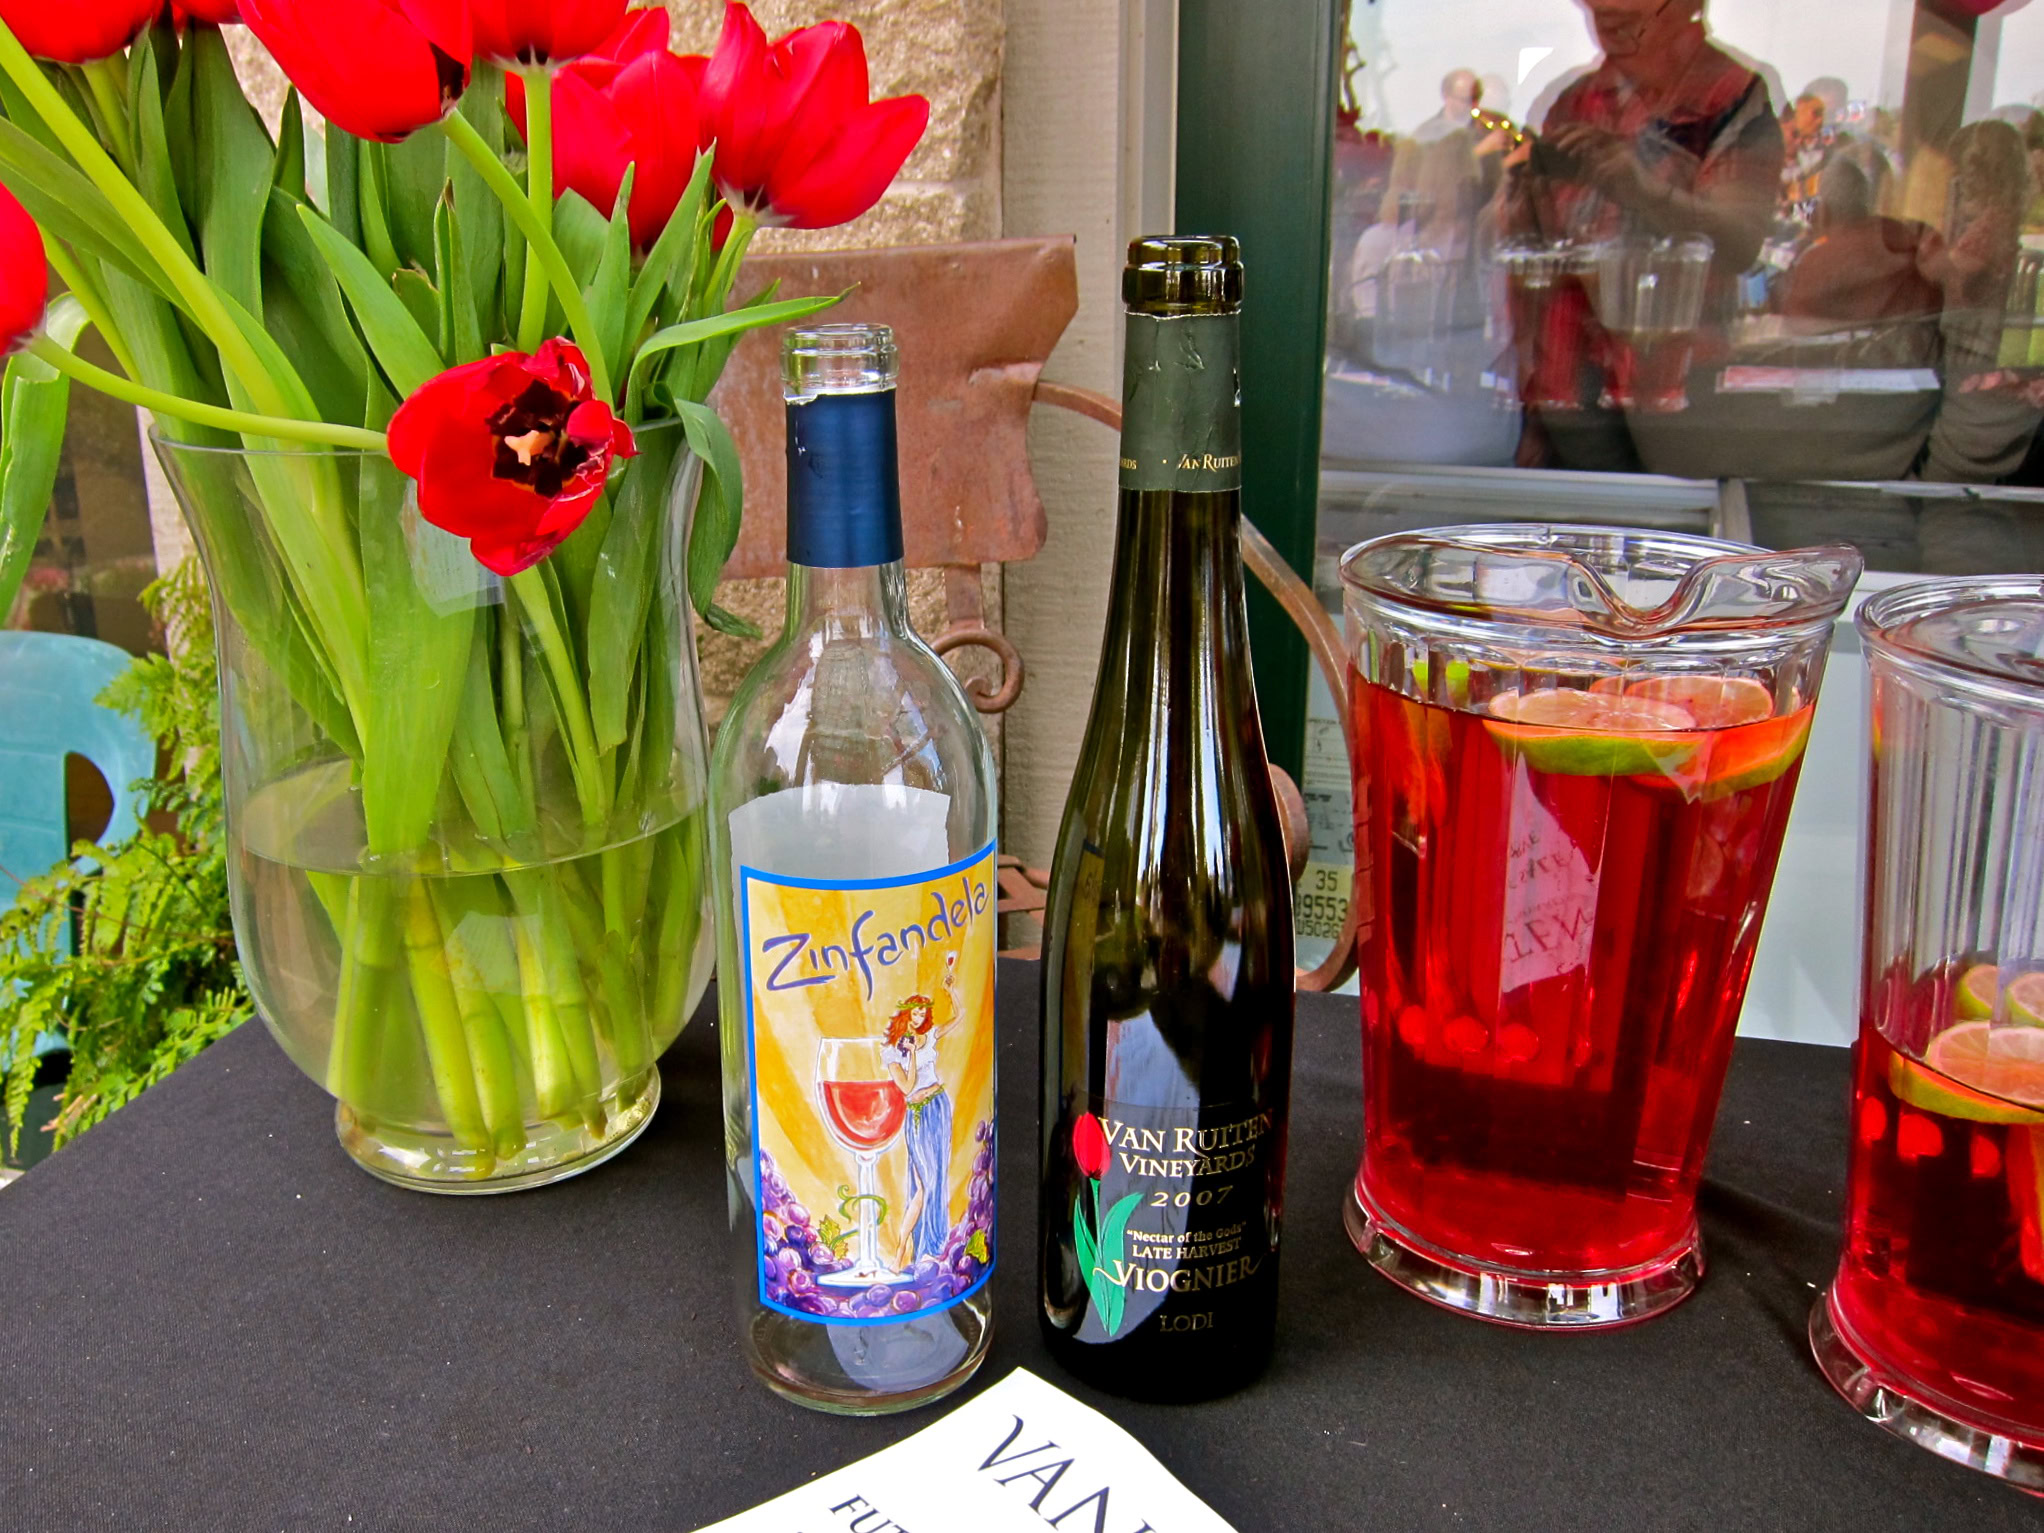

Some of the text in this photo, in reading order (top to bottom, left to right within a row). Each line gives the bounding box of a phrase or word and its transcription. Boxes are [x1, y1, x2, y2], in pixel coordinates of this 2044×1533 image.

[1316, 869, 1338, 892] 35
[762, 876, 990, 1002] Zinfandela
[1098, 1108, 1274, 1158] VAN RUITEN
[1119, 1146, 1256, 1178] VINEYARDS
[1150, 1185, 1234, 1208] 2007
[1132, 1237, 1242, 1260] LATE HARVEST
[1177, 1232, 1192, 1244] of
[1194, 1229, 1213, 1242] the
[1096, 1255, 1261, 1293] VIOGNIER
[1159, 1311, 1215, 1333] LODI
[977, 1414, 1157, 1533] VAN
